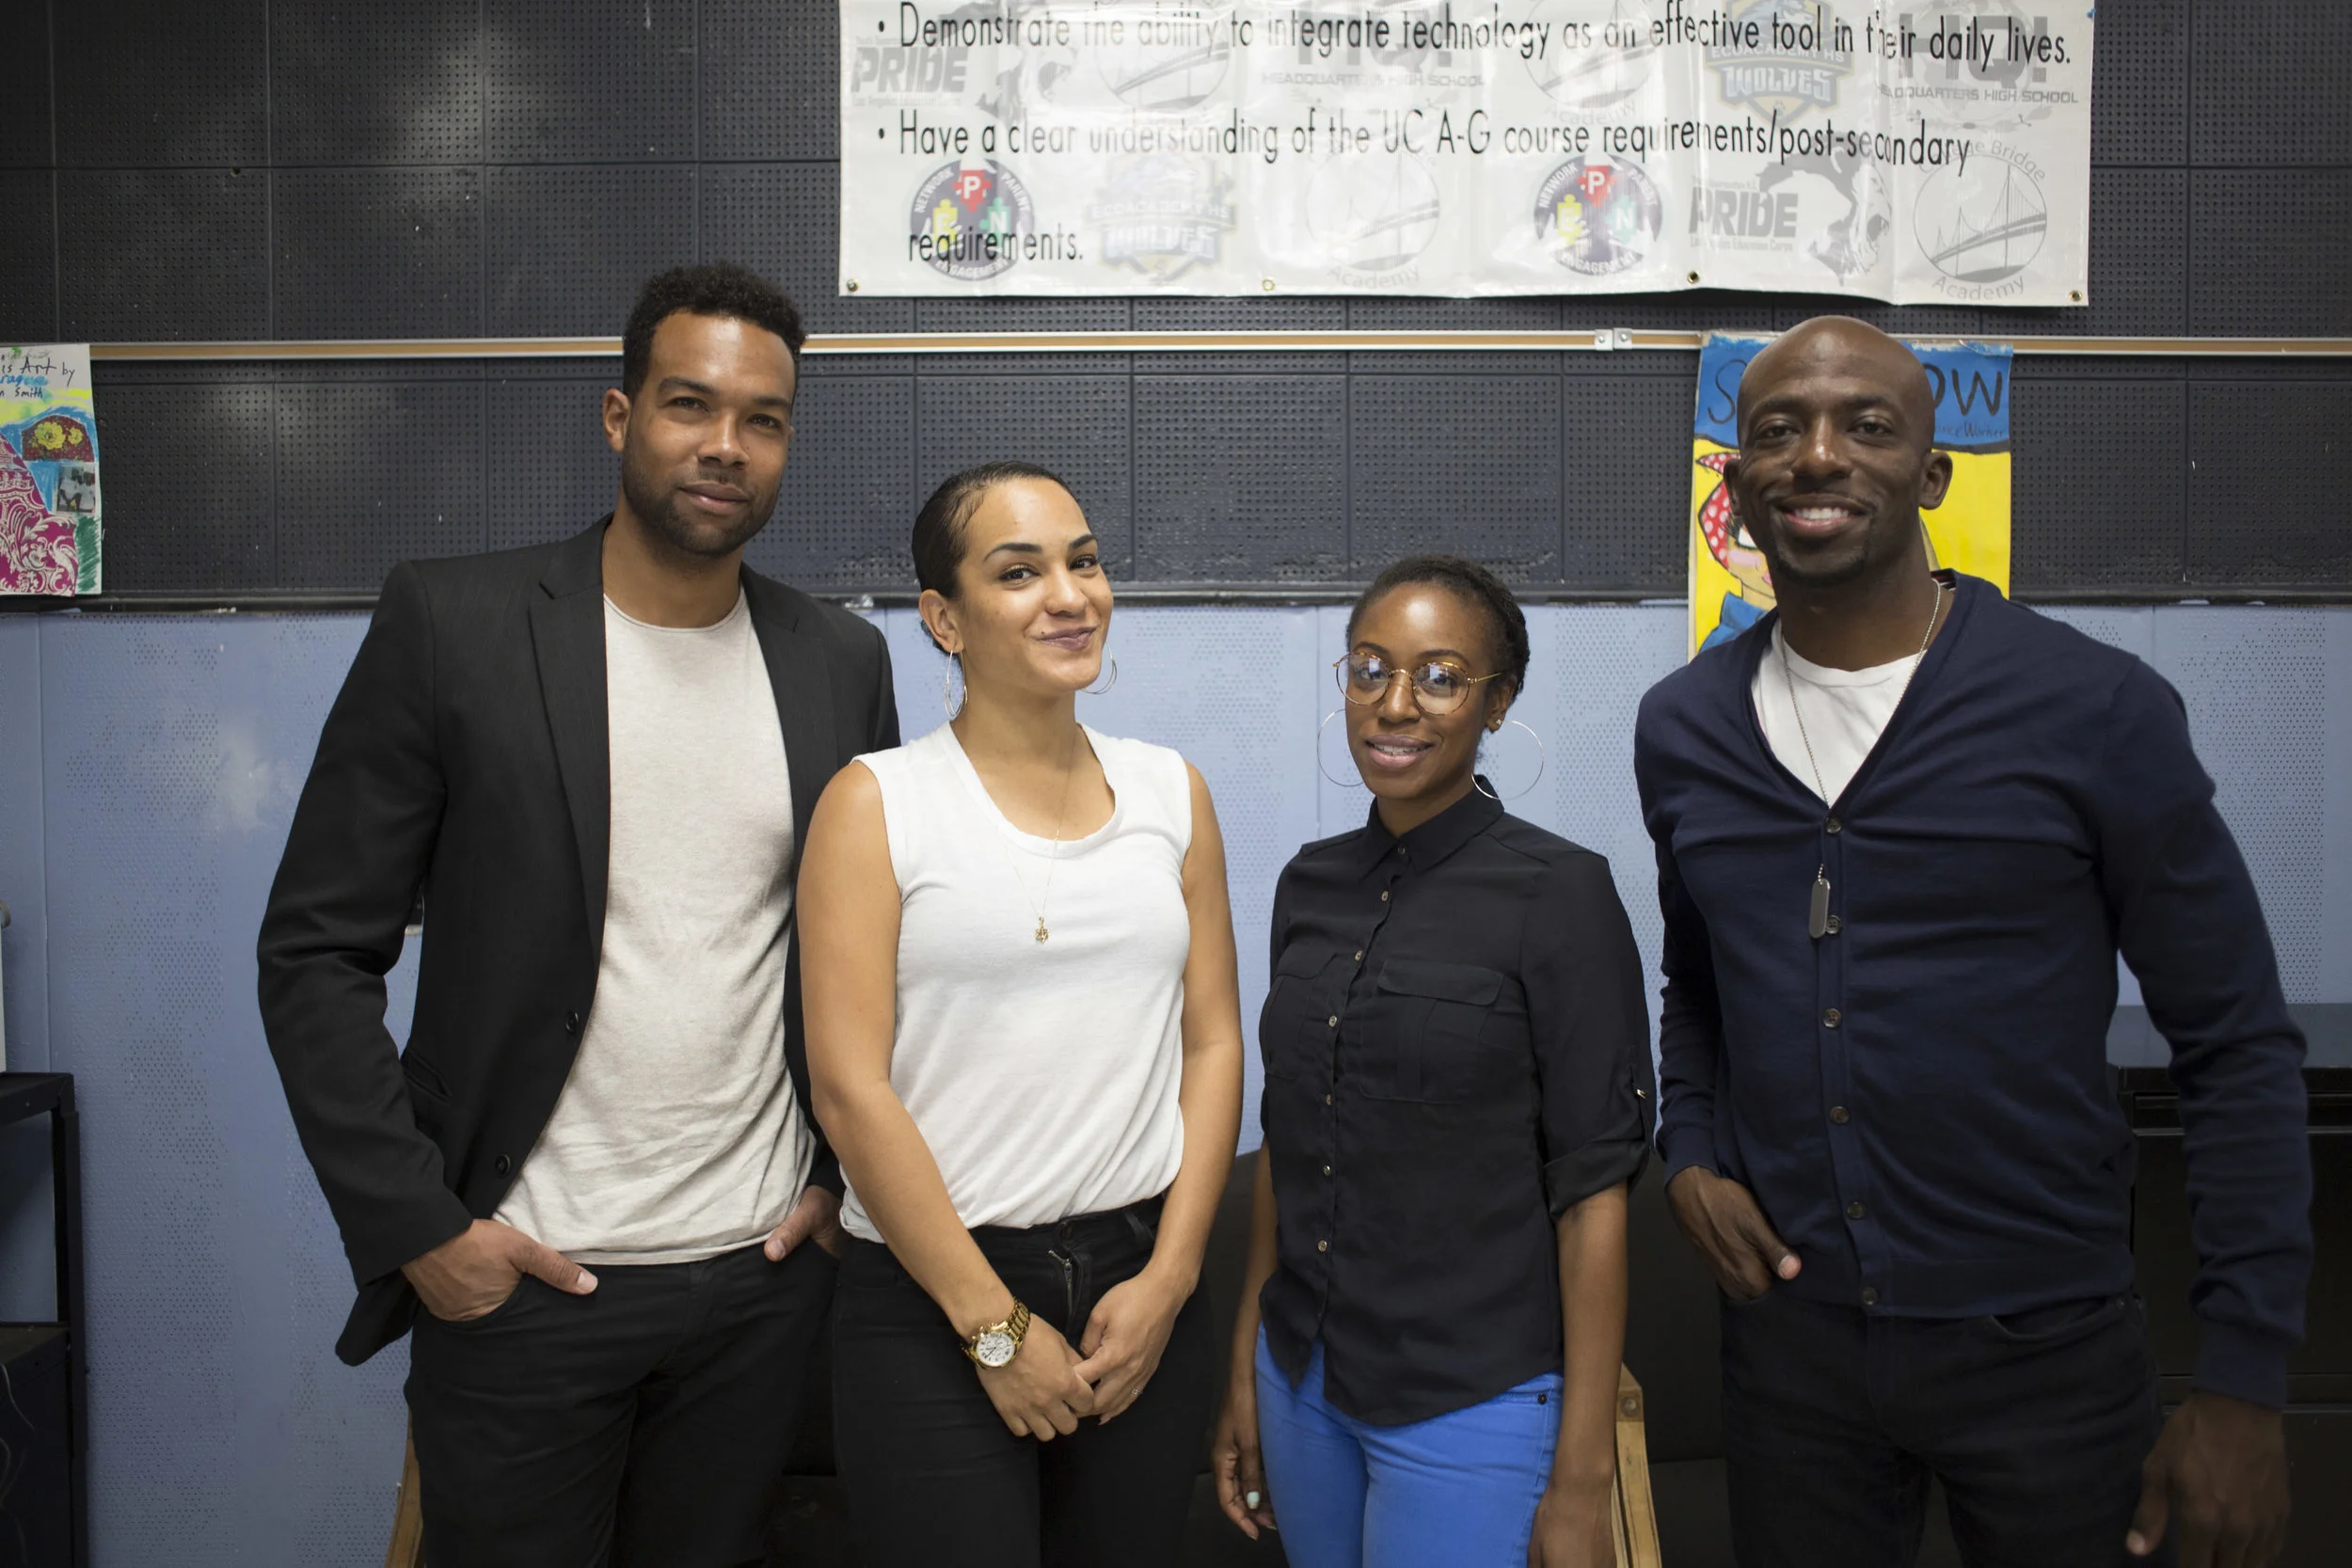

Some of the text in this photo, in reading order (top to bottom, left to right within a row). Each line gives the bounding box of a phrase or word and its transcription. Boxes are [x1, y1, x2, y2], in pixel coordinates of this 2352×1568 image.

[900, 2, 1070, 48] Demonstrate
[1231, 9, 1254, 48] to
[1268, 9, 1390, 58] integrate
[1404, 1, 1550, 60] technology
[1563, 22, 1592, 49] as
[1604, 22, 1636, 49] an
[1648, 0, 1760, 49] effective
[1772, 4, 1821, 53] tool
[1835, 16, 1854, 53] in
[1866, 9, 1916, 59] their
[1930, 14, 1994, 72] daily
[2007, 15, 2072, 64] lives.
[850, 47, 968, 93] PRIDE
[1720, 65, 1834, 103] WOLVES
[1983, 88, 2022, 103] HIGH
[2023, 89, 2079, 103] SCHOOL
[899, 108, 970, 156] Have
[981, 124, 997, 154] a
[1008, 107, 1076, 154] clear
[1089, 107, 1279, 164] understanding
[1291, 105, 1317, 154] of
[1328, 107, 1371, 153] the
[1383, 108, 1424, 154] UC
[1436, 107, 1491, 154] A-G
[1505, 124, 1590, 154] course
[1603, 106, 1970, 177] requirements/post-secondary
[1991, 139, 2045, 182] Bridge
[908, 222, 1084, 273] requirements.
[1931, 274, 2025, 301] Academy
[20, 356, 57, 375] Art
[62, 361, 75, 388] by
[15, 387, 43, 398] Smith
